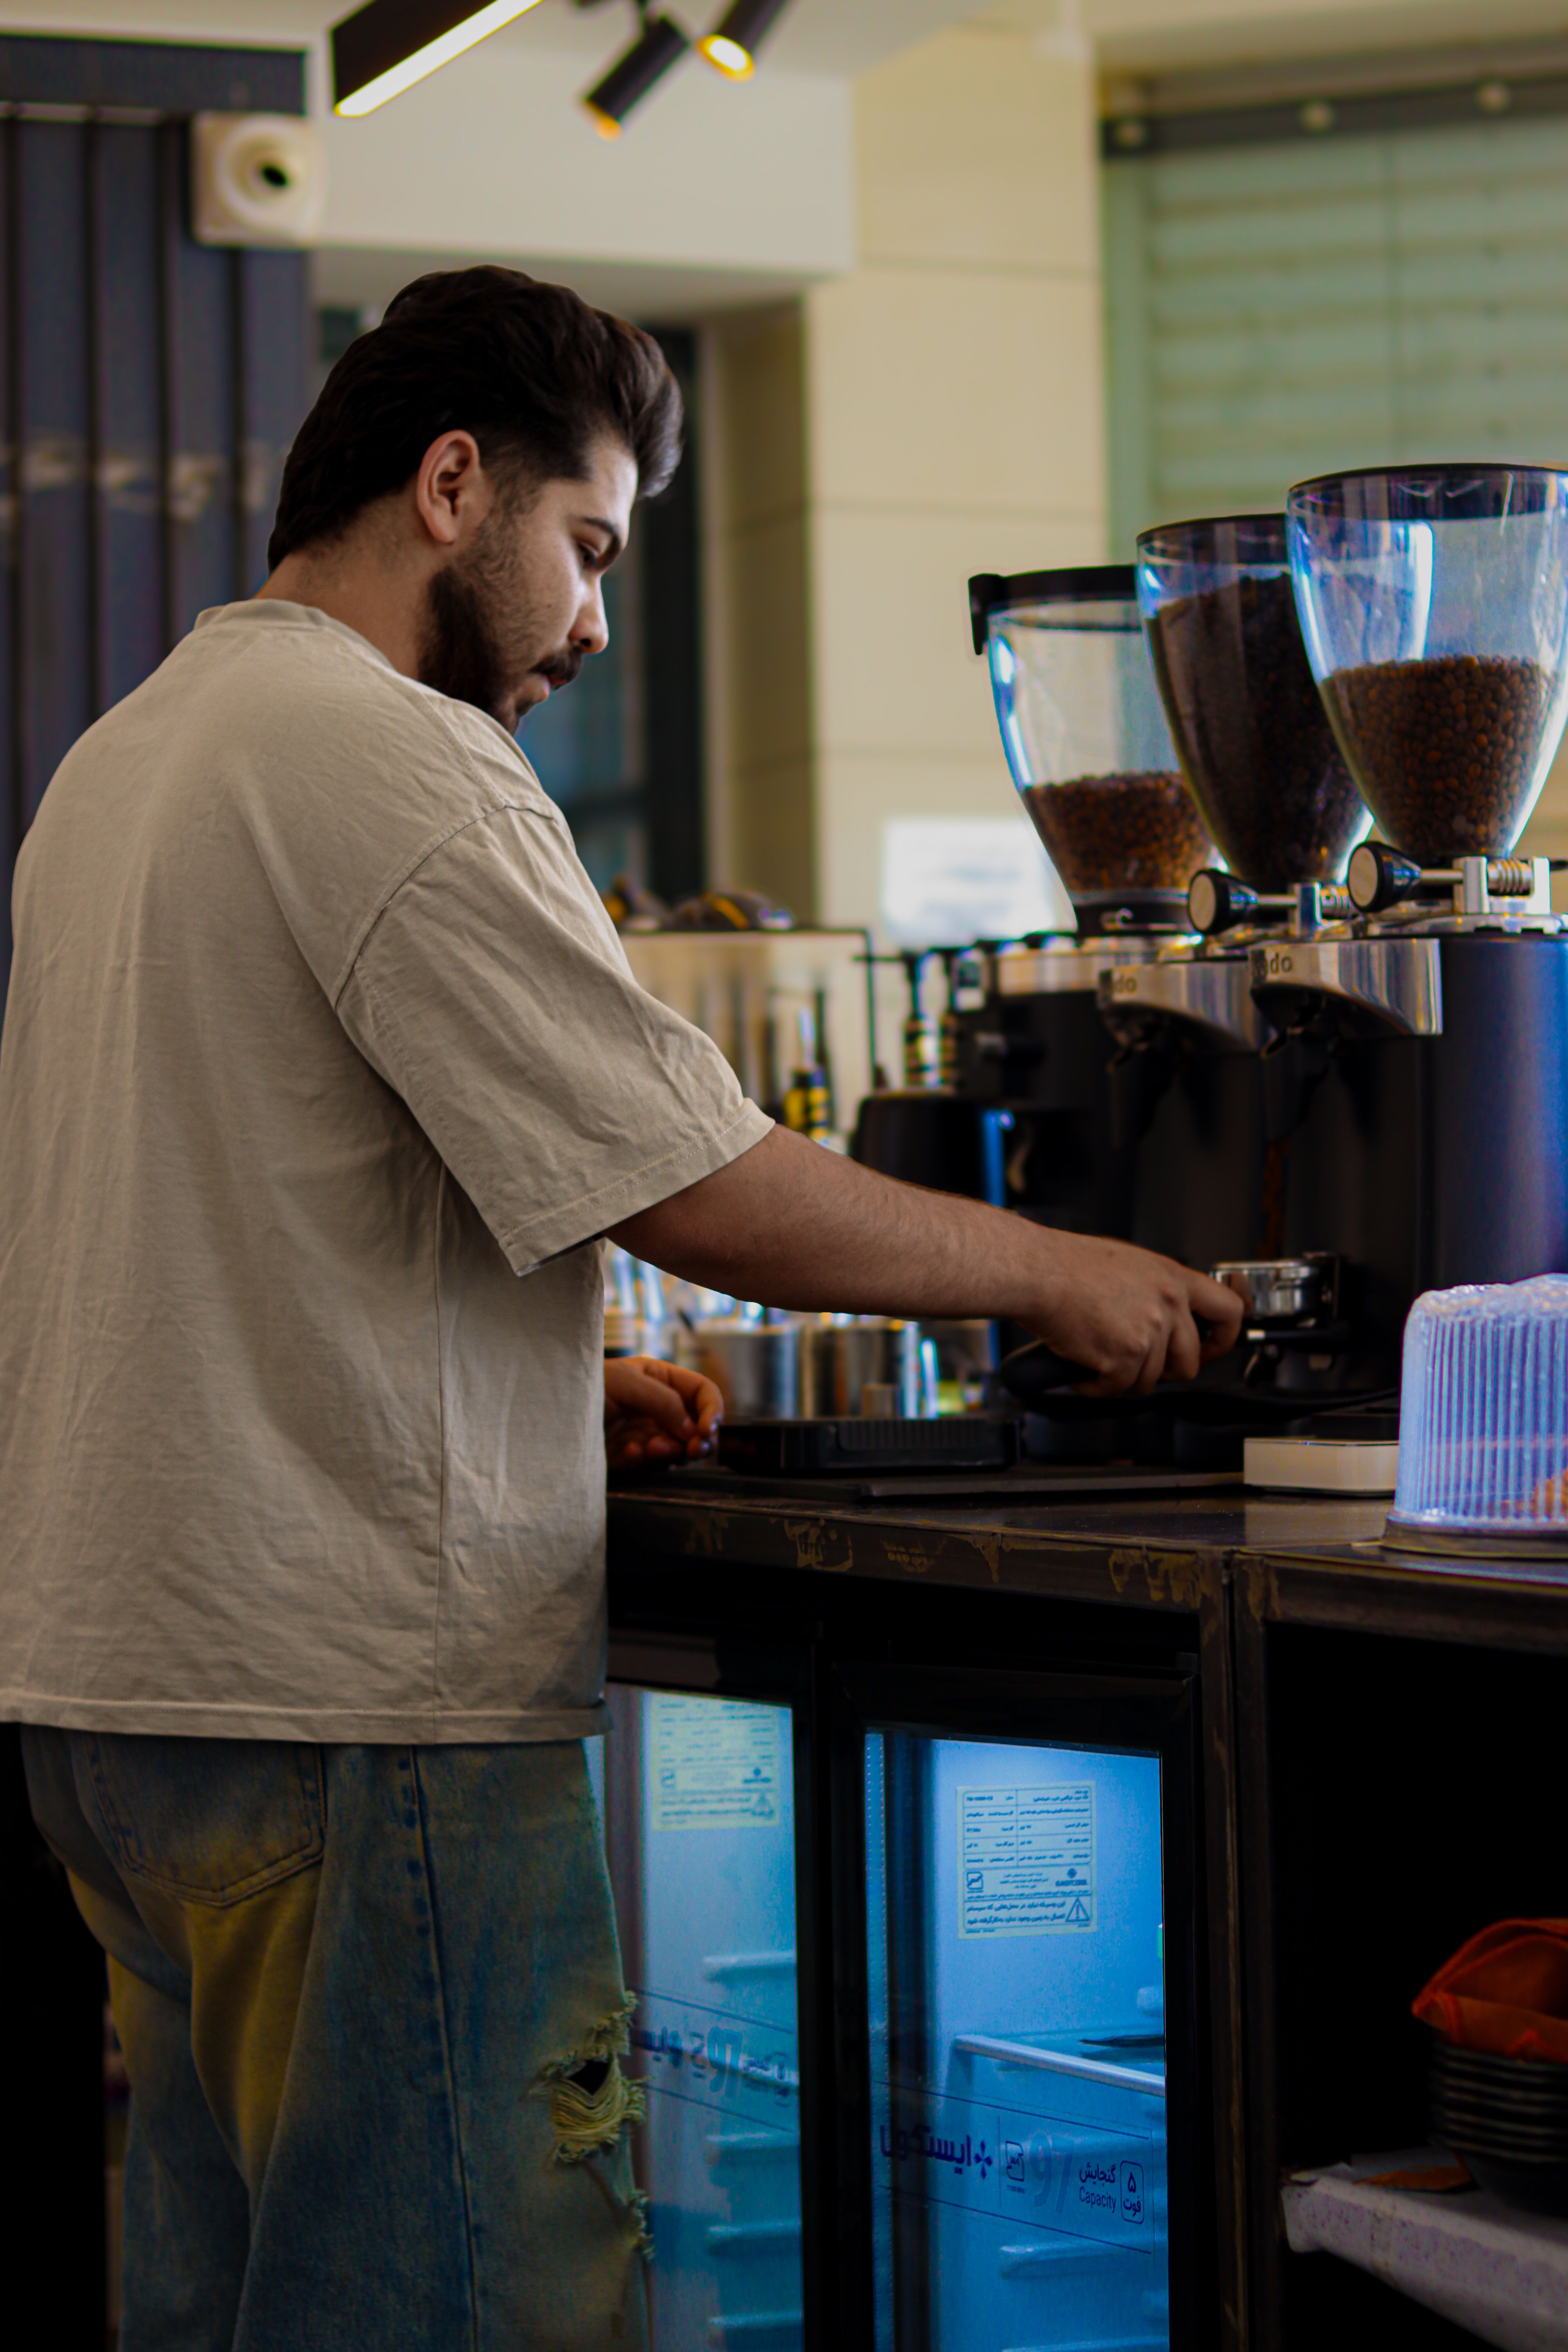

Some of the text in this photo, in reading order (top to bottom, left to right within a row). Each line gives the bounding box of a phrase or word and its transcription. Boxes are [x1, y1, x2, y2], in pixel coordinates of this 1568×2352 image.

[1029, 2132, 1074, 2213] 97
[1079, 2161, 1116, 2187] گنجایش
[1079, 2187, 1116, 2214] Capacity
[1123, 2196, 1141, 2217] فوت
